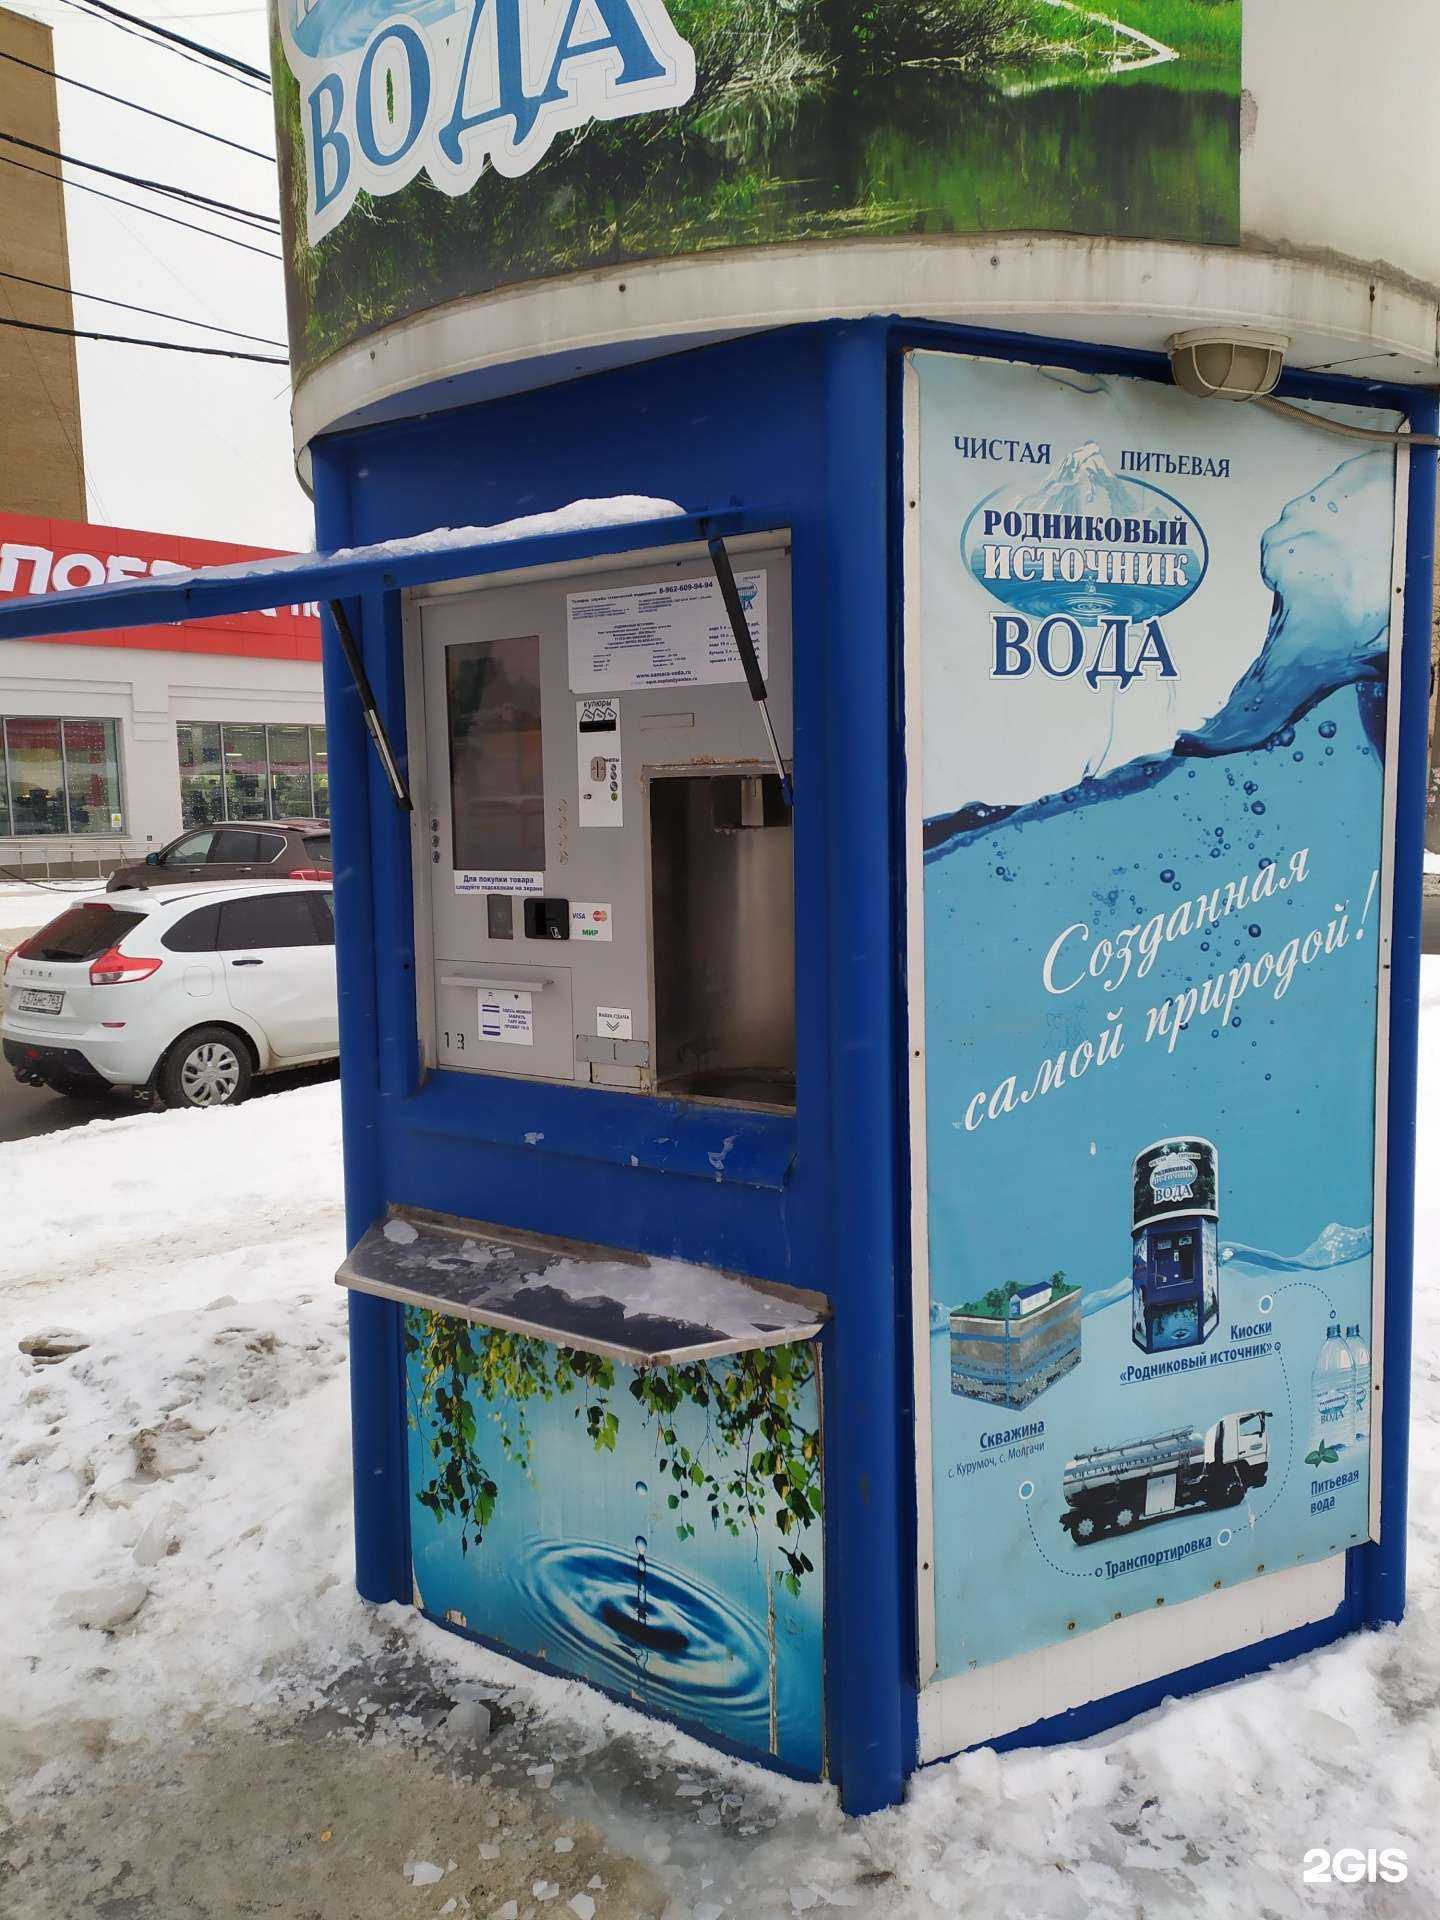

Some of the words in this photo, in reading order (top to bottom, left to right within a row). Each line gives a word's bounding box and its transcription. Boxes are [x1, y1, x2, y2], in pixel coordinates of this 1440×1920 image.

[307, 0, 667, 216] ВОДА
[953, 435, 1051, 465] ЧИСТАЯ
[1120, 449, 1231, 478] ПИТЬЕВАЯ
[983, 509, 1188, 546] РОДНИКОВЫЙ
[982, 544, 1190, 587] ИСТОЧНИК
[991, 614, 1179, 691] ВОДА
[583, 700, 611, 709] купюры
[463, 875, 477, 883] Для
[478, 876, 507, 884] покупки
[510, 877, 534, 885] товара
[582, 928, 598, 936] МИР
[1042, 847, 1311, 995] Созданная
[964, 1006, 1126, 1131] самой
[1145, 869, 1379, 1054] природой!
[1155, 1184, 1192, 1202] ВОДА
[1230, 1321, 1272, 1340] Киоски
[1119, 1352, 1207, 1381] «Родниковый
[1210, 1342, 1273, 1364] источник»
[979, 1420, 1045, 1449] Скважина
[948, 1469, 955, 1479] с.
[956, 1456, 997, 1478] Курумоч,
[999, 1454, 1006, 1463] с.
[1008, 1442, 1045, 1460] Молгачи
[1310, 1468, 1360, 1495] Питьевая
[1310, 1496, 1336, 1513] вода
[1105, 1534, 1212, 1577] Транспортировка
